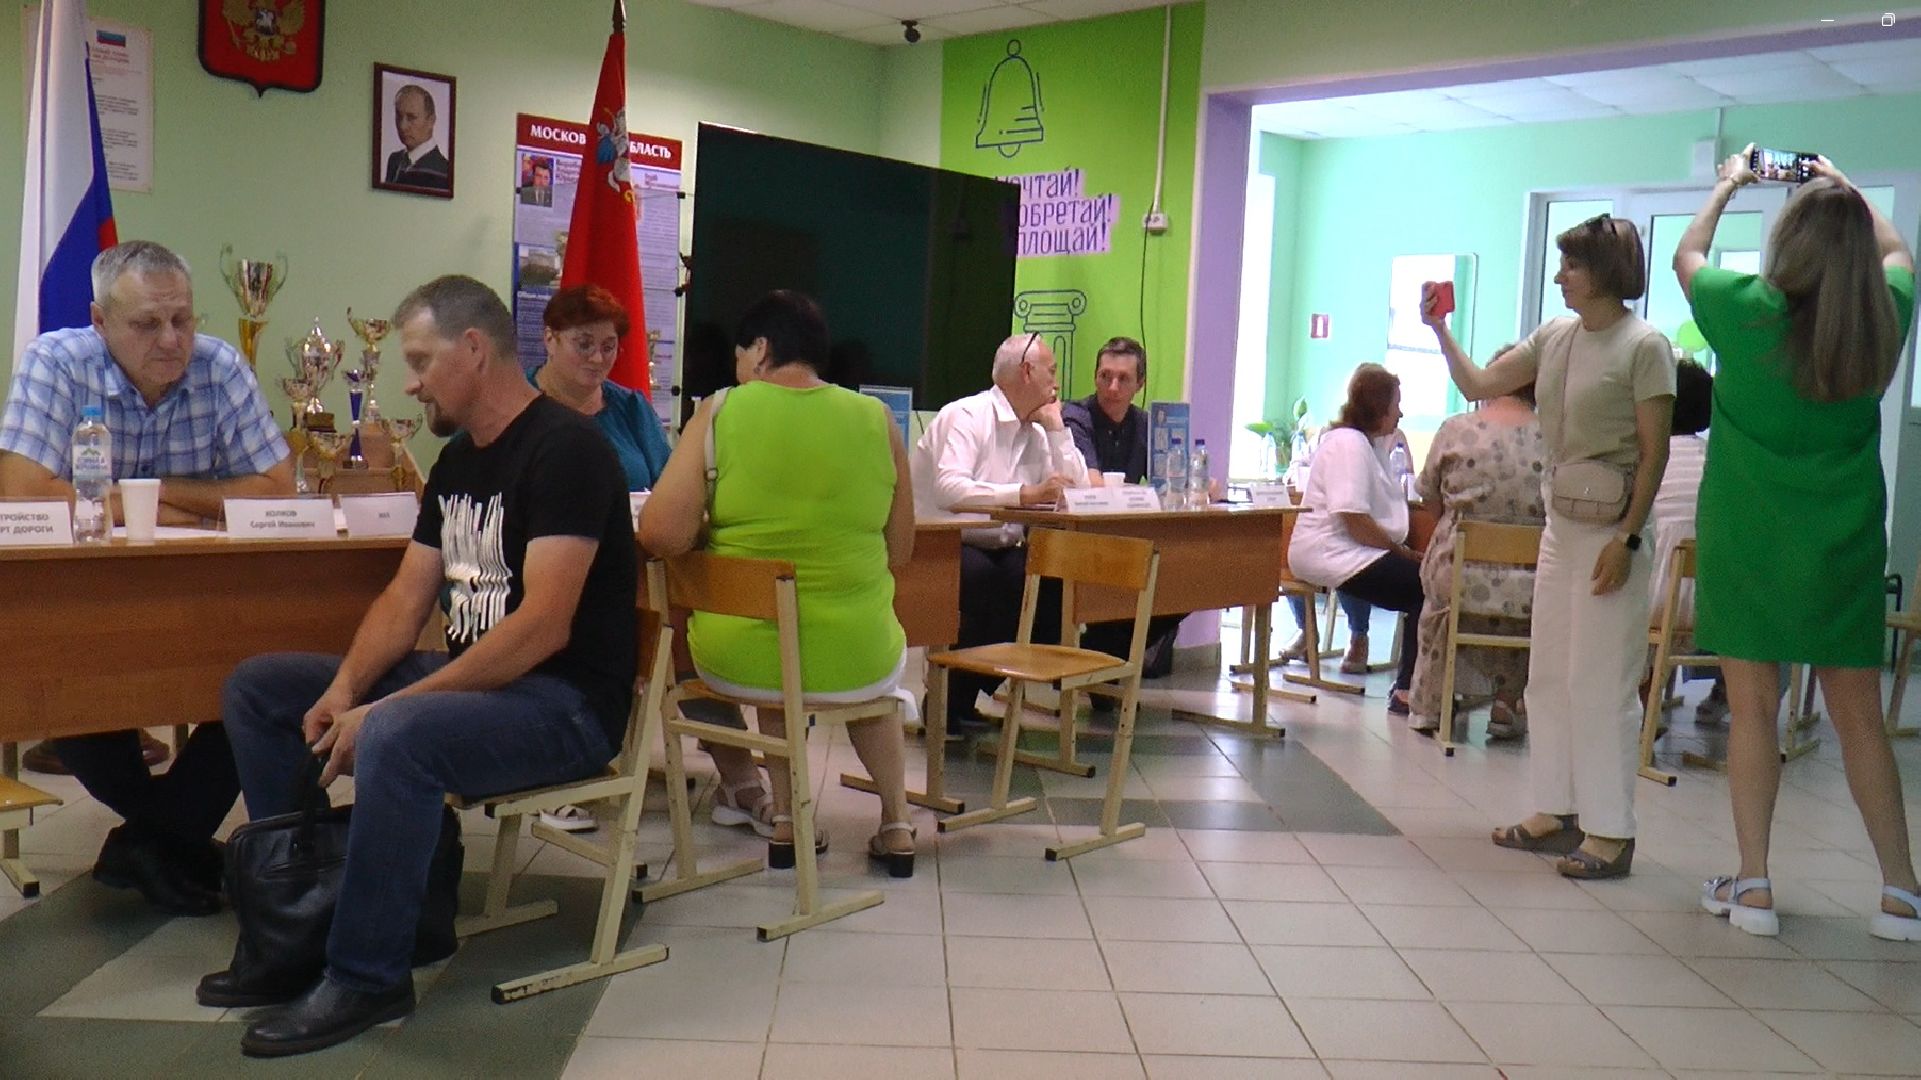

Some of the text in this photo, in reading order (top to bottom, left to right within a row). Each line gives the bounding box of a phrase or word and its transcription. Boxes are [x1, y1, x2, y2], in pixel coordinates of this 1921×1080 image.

[530, 124, 672, 159] МОСКОВ БЛАСТЬ
[994, 165, 1080, 199] чтай!
[13, 525, 54, 534] ДОРОГИ
